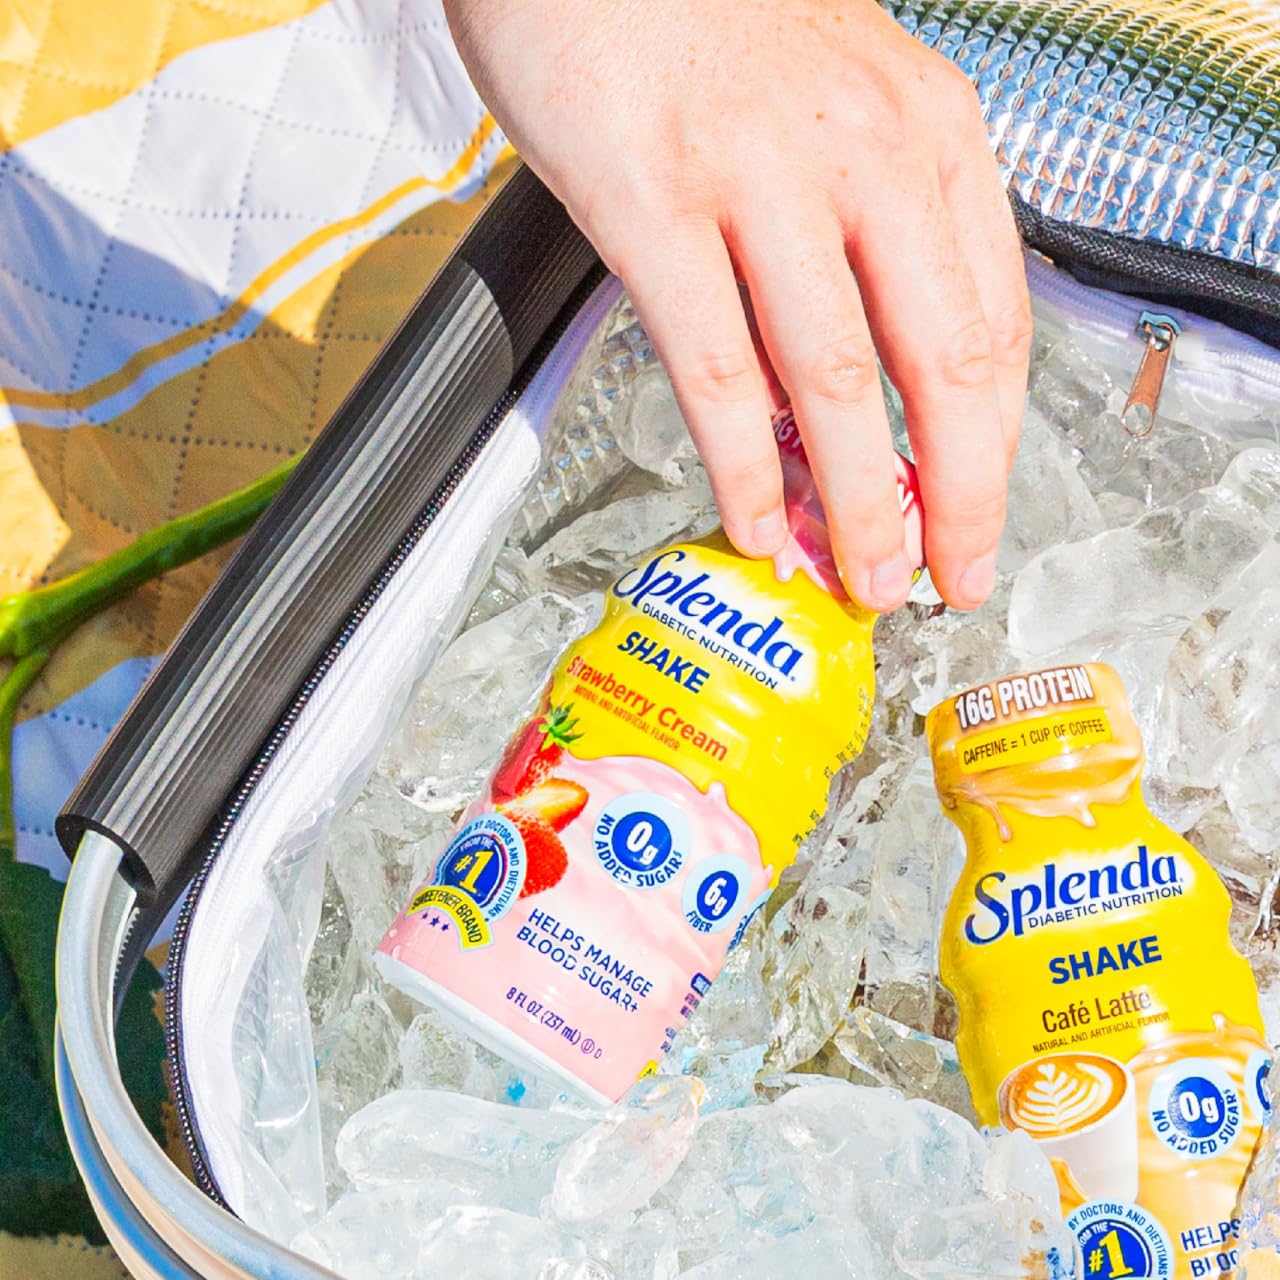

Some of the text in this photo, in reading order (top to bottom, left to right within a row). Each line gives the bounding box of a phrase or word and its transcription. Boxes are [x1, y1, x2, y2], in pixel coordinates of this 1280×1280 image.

[612, 550, 804, 677] Splenda
[617, 631, 711, 694] SHAKE
[642, 603, 778, 690] DIABETIC NUTRITION
[566, 656, 729, 762] Strawberry Cream
[955, 667, 1093, 728] 16G PROTEIN
[651, 727, 681, 751] FLAVOR
[963, 719, 1105, 765] CAFFEINE CUP OF COFFEE
[595, 813, 632, 884] NO ADDED
[626, 821, 659, 865] 0g
[454, 851, 494, 895] #1
[965, 845, 1178, 945] Splenda
[704, 877, 728, 916] 6g
[1028, 885, 1183, 928] DIABETIC NUTRITION
[456, 901, 482, 943] BRAND
[686, 910, 713, 933] FIBER
[516, 925, 578, 971] BLOOD
[579, 966, 639, 1013] SUGAR+
[527, 908, 585, 951] HELPS
[584, 944, 653, 998] MANAGE
[1048, 935, 1162, 985] SHAKE
[506, 987, 544, 1019] 8 OZ
[1042, 990, 1152, 1033] Café Latte
[1033, 1012, 1170, 1054] NATURAL AND ARTIFICIAL FLAVOR
[1179, 1091, 1220, 1123] 0g
[1152, 1110, 1217, 1155] NO ADDED
[1080, 1203, 1168, 1276] DOCTORS AND DIETITIANS
[1088, 1230, 1134, 1279] #1
[1181, 1219, 1240, 1251] HELPS
